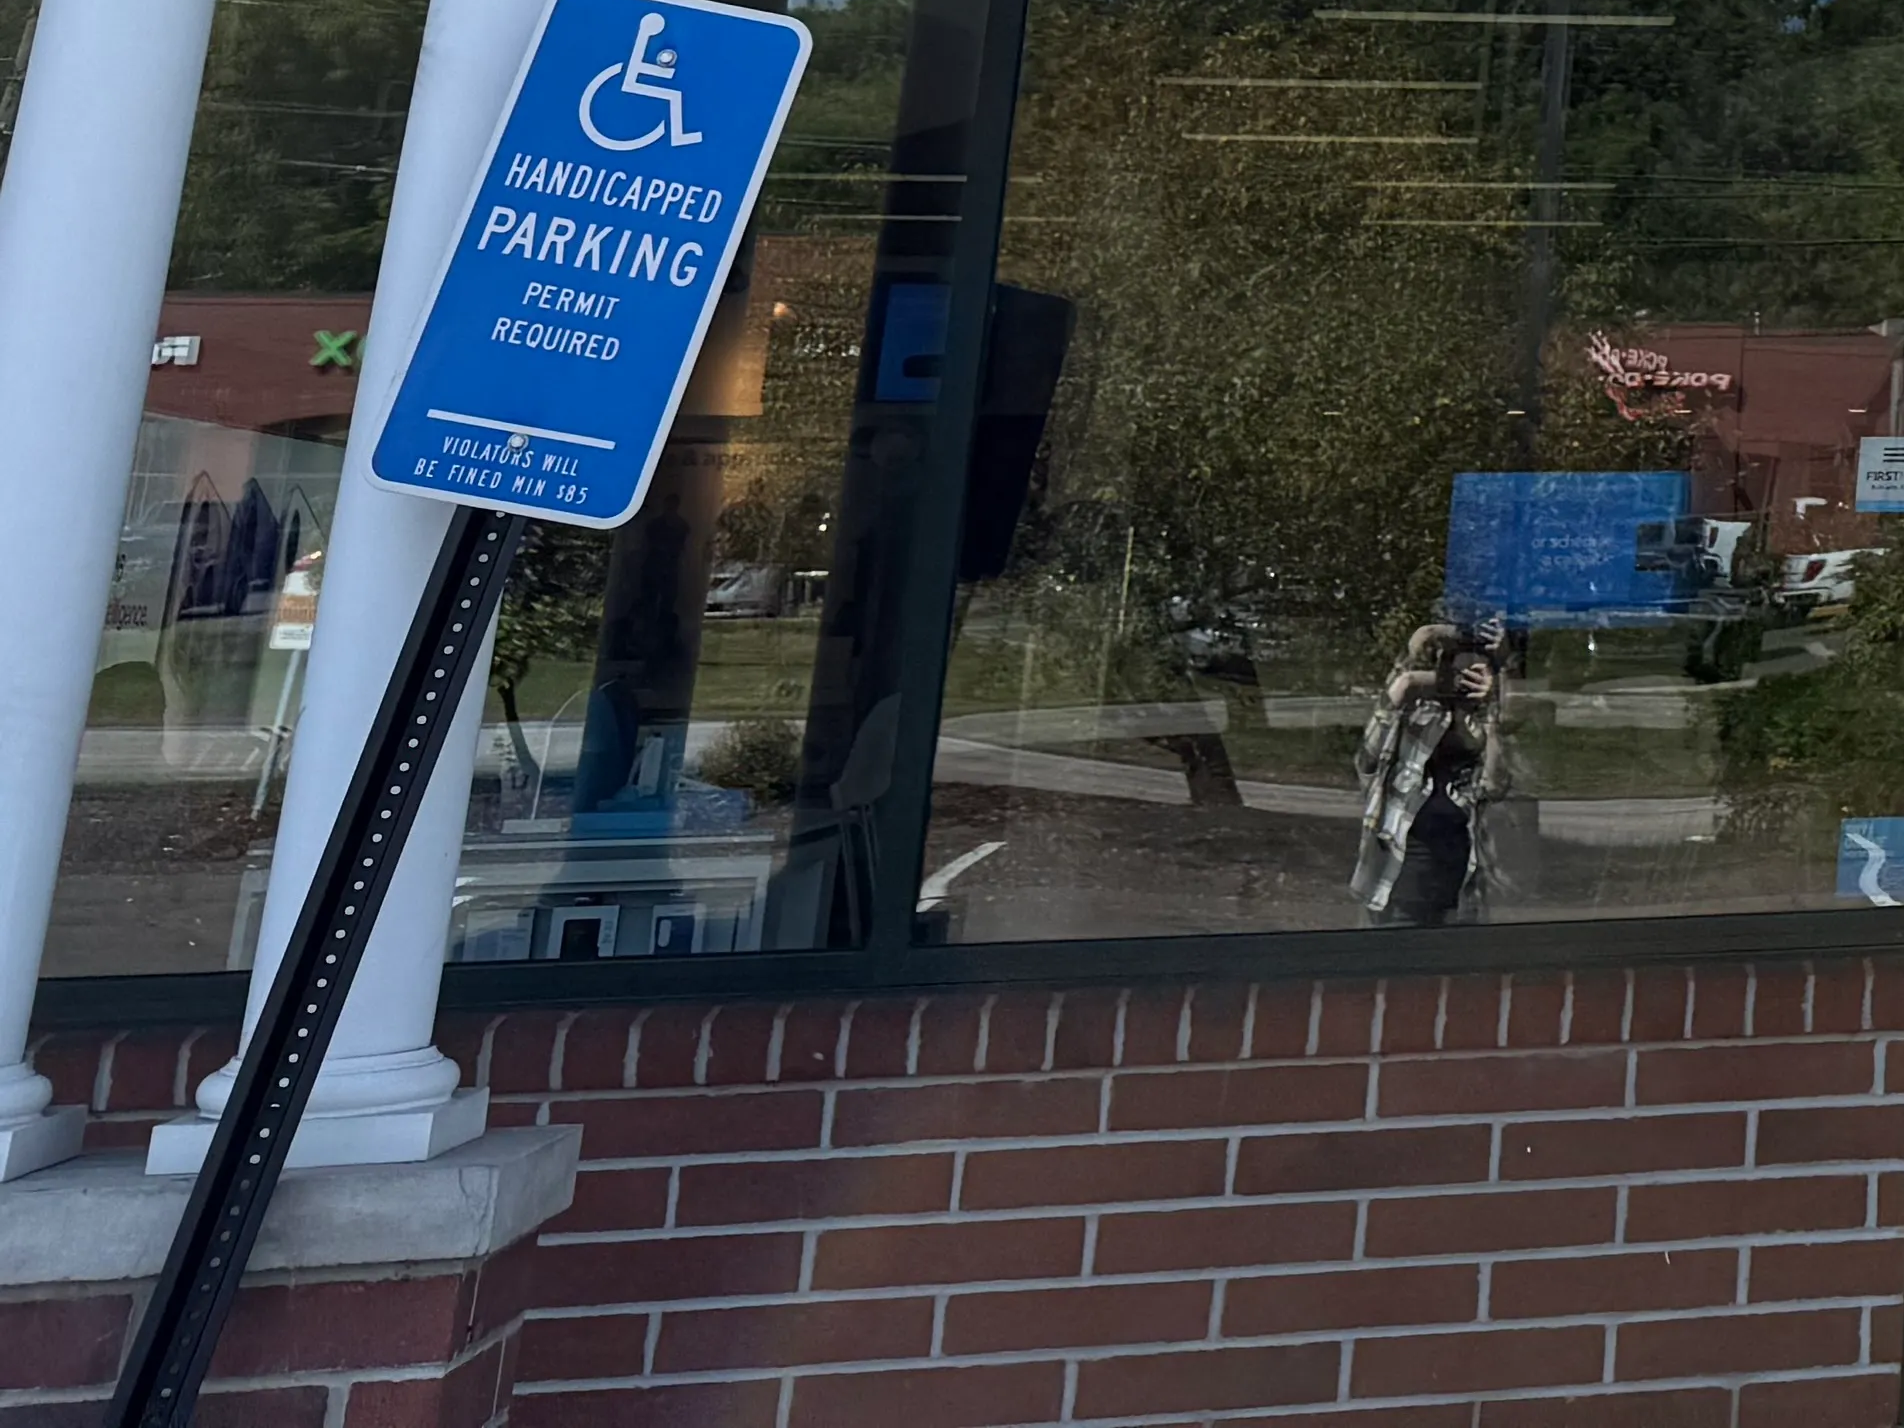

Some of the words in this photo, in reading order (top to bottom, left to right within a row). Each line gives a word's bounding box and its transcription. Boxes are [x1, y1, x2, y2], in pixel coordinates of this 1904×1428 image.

[504, 152, 723, 223] HANDICAPPED
[477, 205, 703, 287] PARKING
[522, 282, 620, 319] PERMIT
[491, 317, 620, 360] REQUIRED
[442, 436, 534, 468] VIOLATORS
[541, 454, 579, 476] WILL
[414, 458, 438, 478] BE
[447, 464, 502, 489] FINED
[511, 476, 546, 496] MIN
[556, 484, 588, 504] $85
